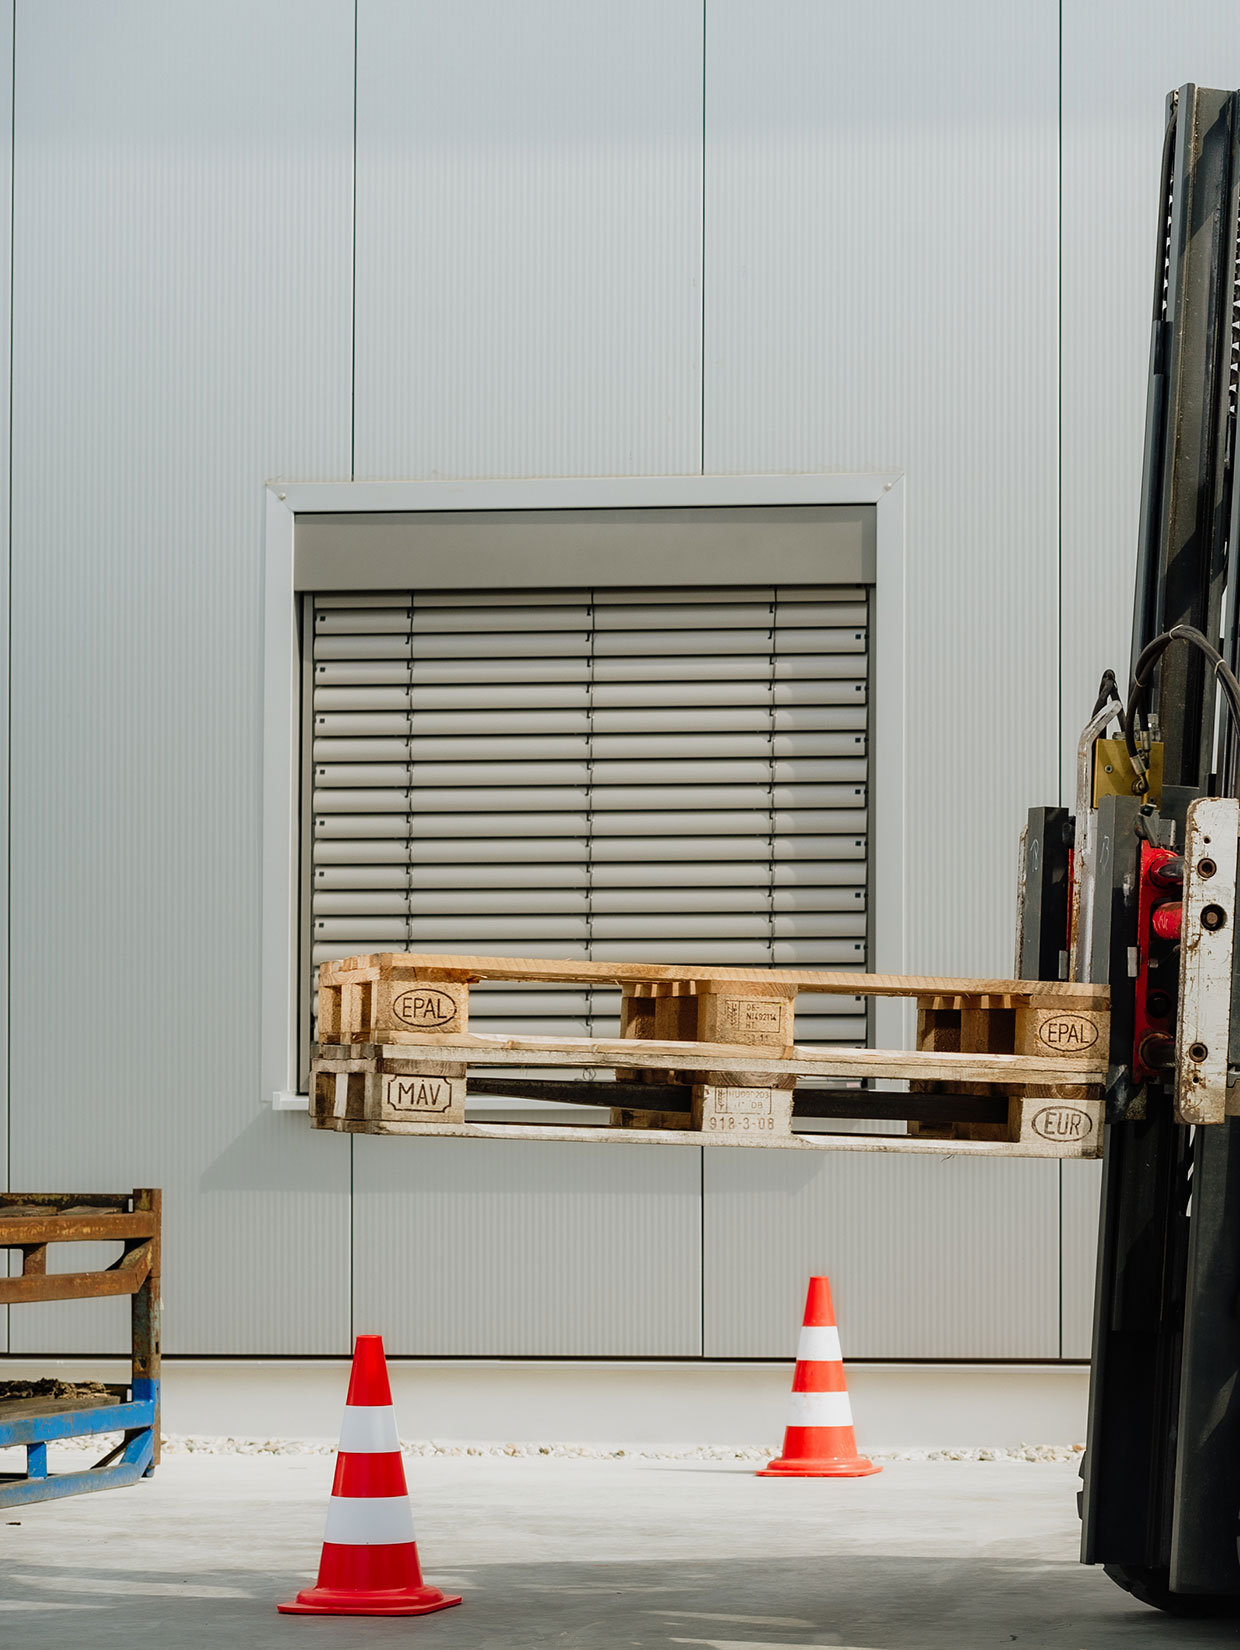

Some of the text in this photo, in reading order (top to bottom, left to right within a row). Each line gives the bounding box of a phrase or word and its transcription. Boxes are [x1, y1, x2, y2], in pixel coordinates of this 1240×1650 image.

[402, 997, 447, 1019] EPAL
[1048, 1023, 1090, 1044] EPAL
[709, 1116, 775, 1131] 918-3-08
[1043, 1111, 1082, 1136] EUR
